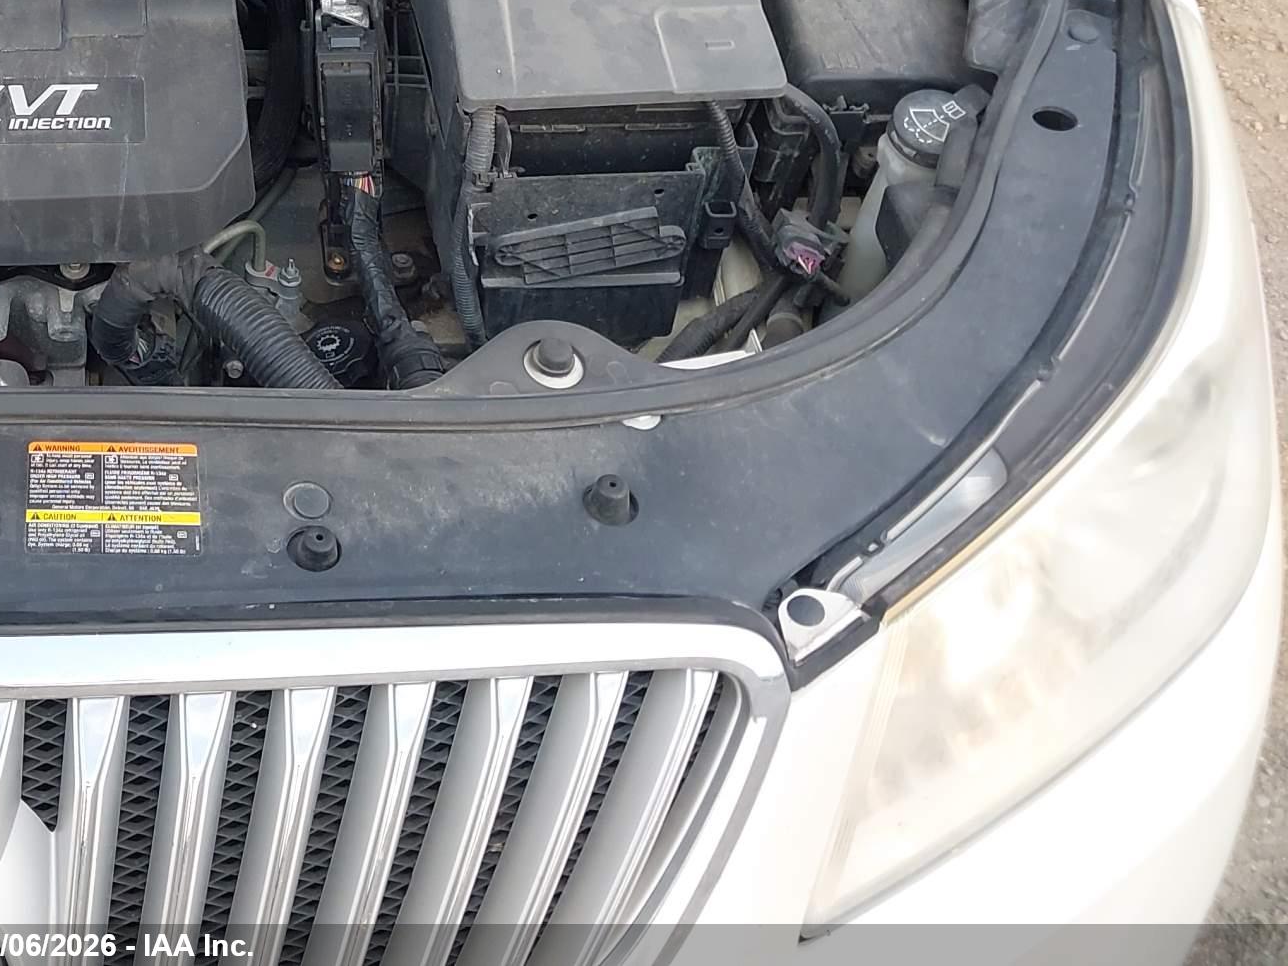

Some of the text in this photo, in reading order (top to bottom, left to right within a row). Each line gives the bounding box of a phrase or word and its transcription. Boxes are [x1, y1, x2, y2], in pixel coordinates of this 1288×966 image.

[9, 117, 111, 130] INJECTION
[118, 446, 179, 454] AVERTISSEMENT
[120, 514, 162, 522] ATTENTION
